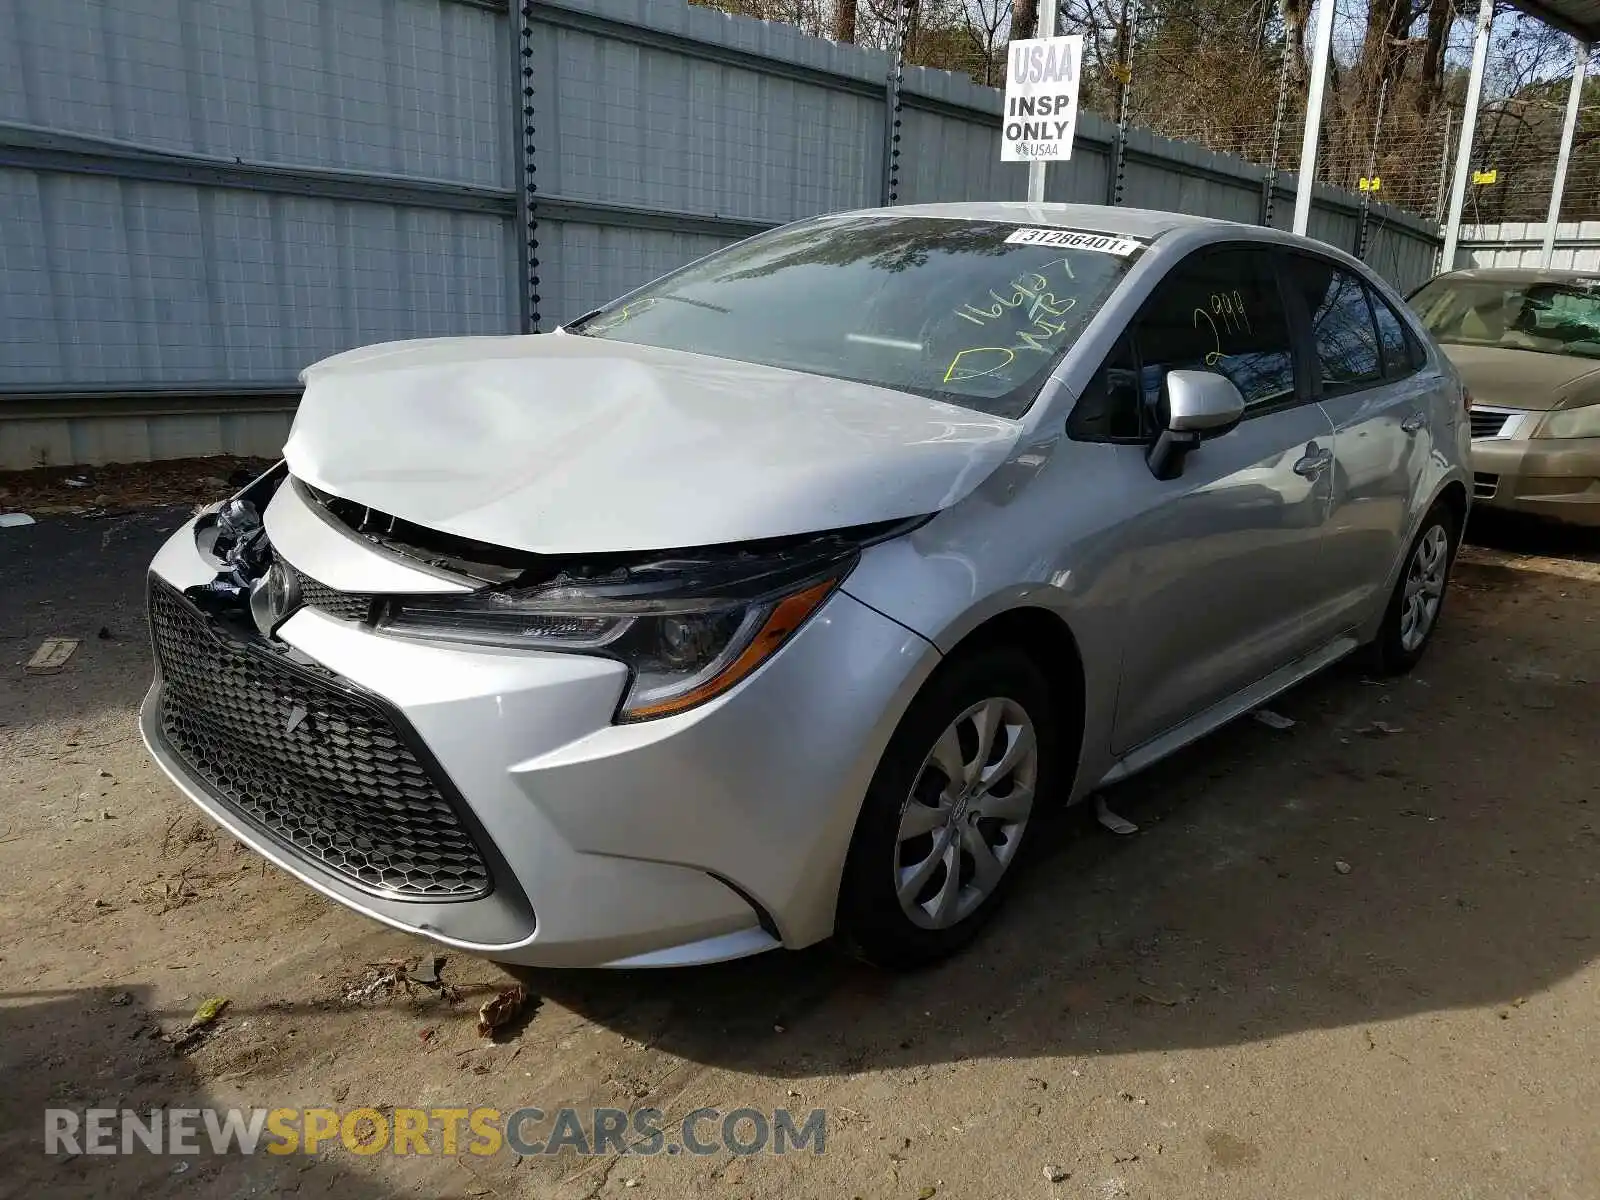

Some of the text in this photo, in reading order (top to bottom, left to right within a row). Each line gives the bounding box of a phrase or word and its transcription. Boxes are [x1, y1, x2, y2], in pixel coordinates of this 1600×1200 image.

[1014, 44, 1073, 84] USAA
[1009, 95, 1070, 117] INSP
[1006, 121, 1069, 141] ONLY
[1030, 143, 1058, 156] USAA
